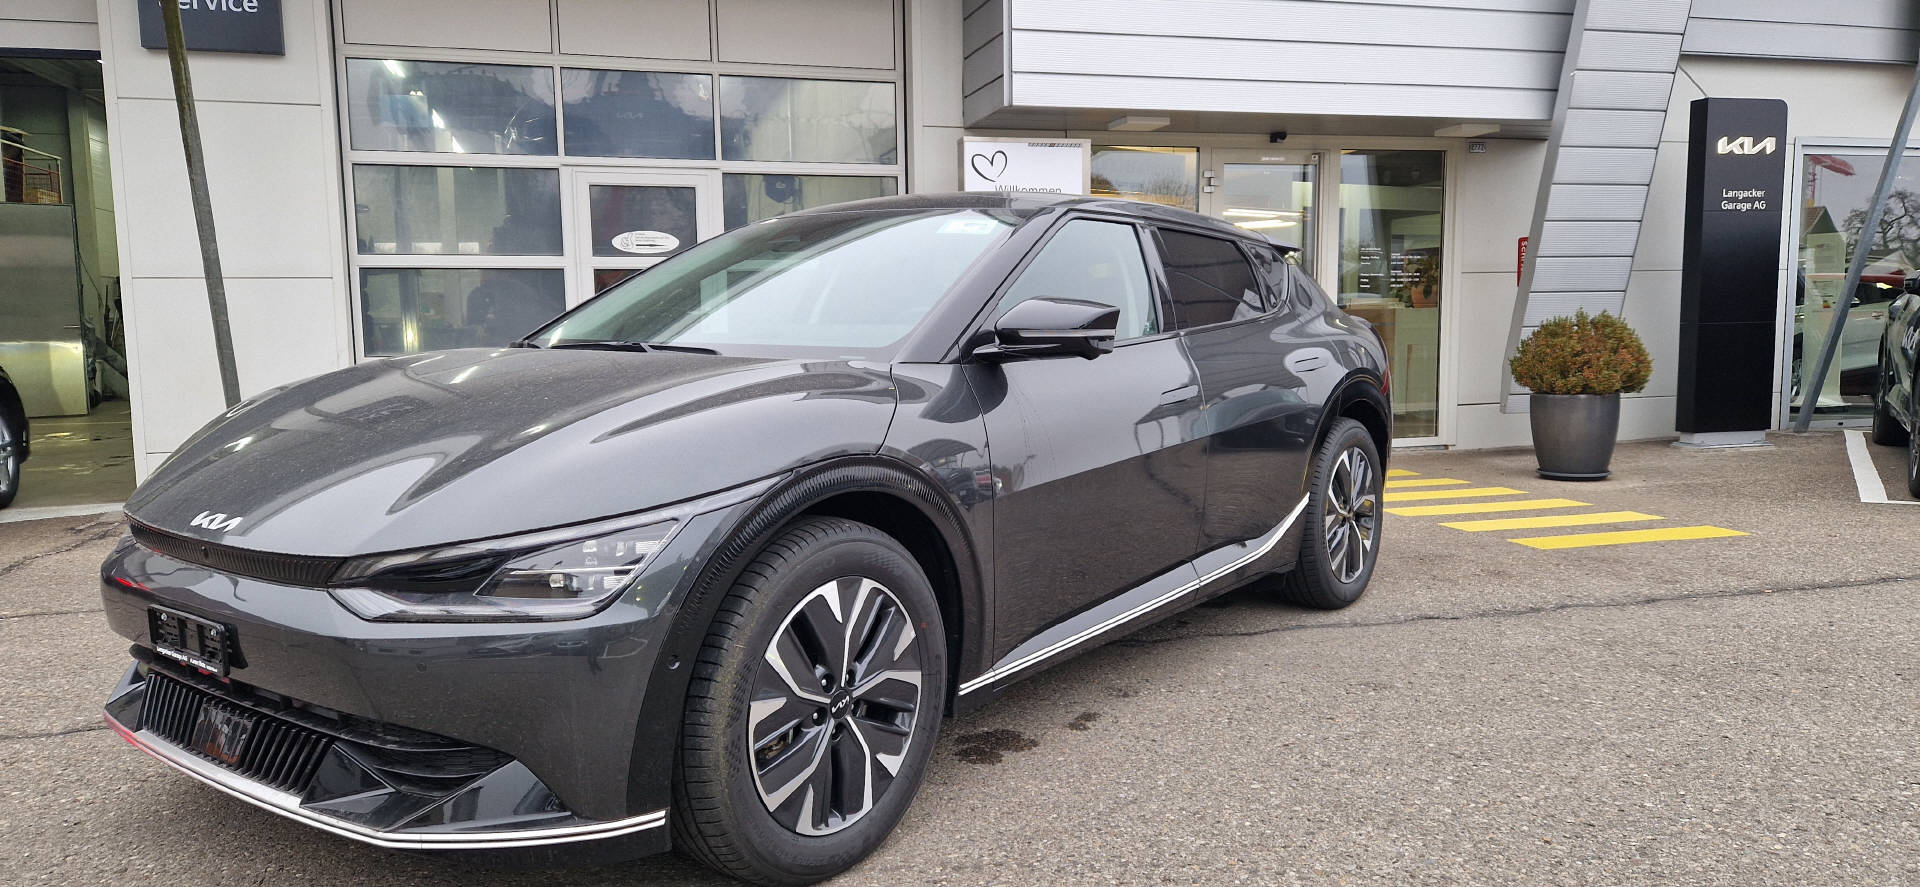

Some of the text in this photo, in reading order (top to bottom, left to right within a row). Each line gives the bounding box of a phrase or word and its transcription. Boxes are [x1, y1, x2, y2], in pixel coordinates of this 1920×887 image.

[158, 0, 258, 12] ervice
[1717, 136, 1777, 155] KIA
[1722, 188, 1766, 199] Langacker
[1721, 200, 1767, 212] Garage AG
[190, 510, 244, 533] KIA
